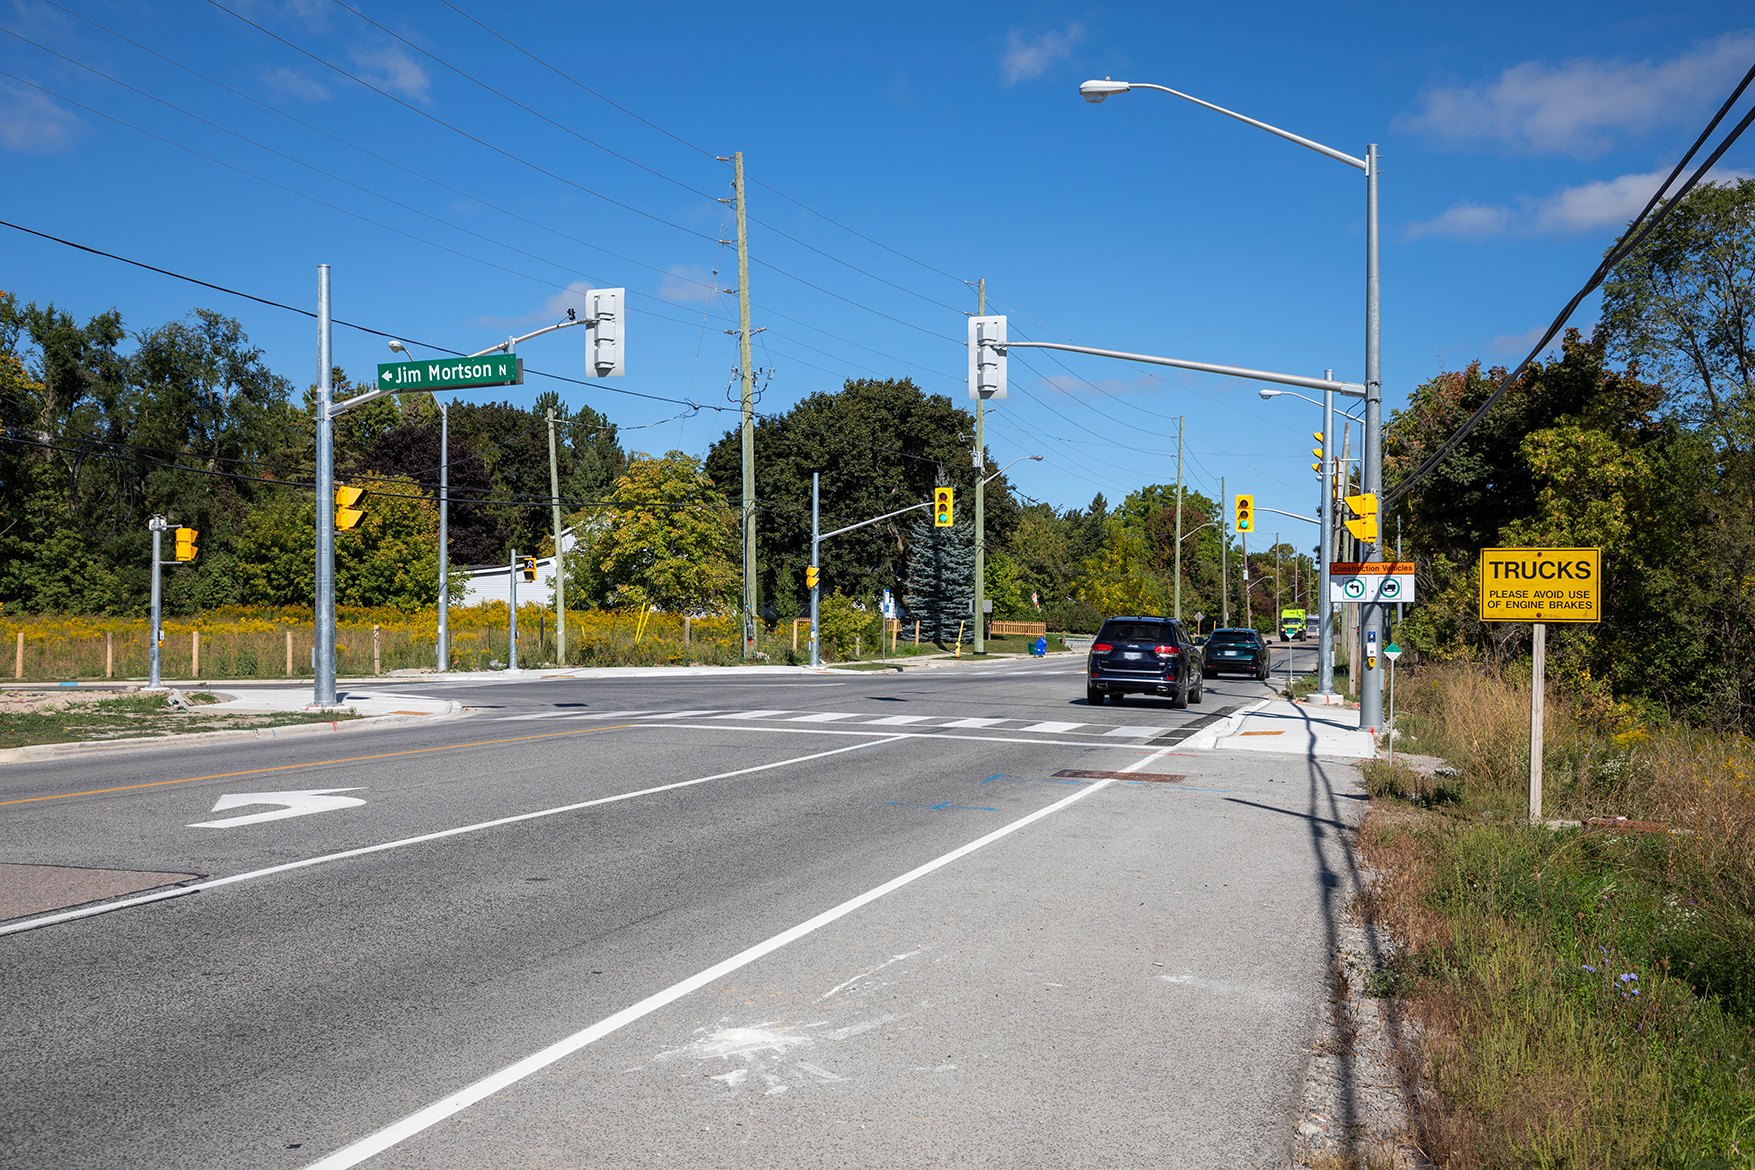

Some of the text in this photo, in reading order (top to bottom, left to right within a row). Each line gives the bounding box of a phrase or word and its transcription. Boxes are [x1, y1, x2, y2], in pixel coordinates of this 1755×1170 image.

[396, 364, 506, 383] Jim Mortson N
[1489, 561, 1591, 579] TRUCKS
[1489, 590, 1590, 599] PLEASE AVOID USE
[1487, 600, 1593, 610] OF ENGINE BRAKES
